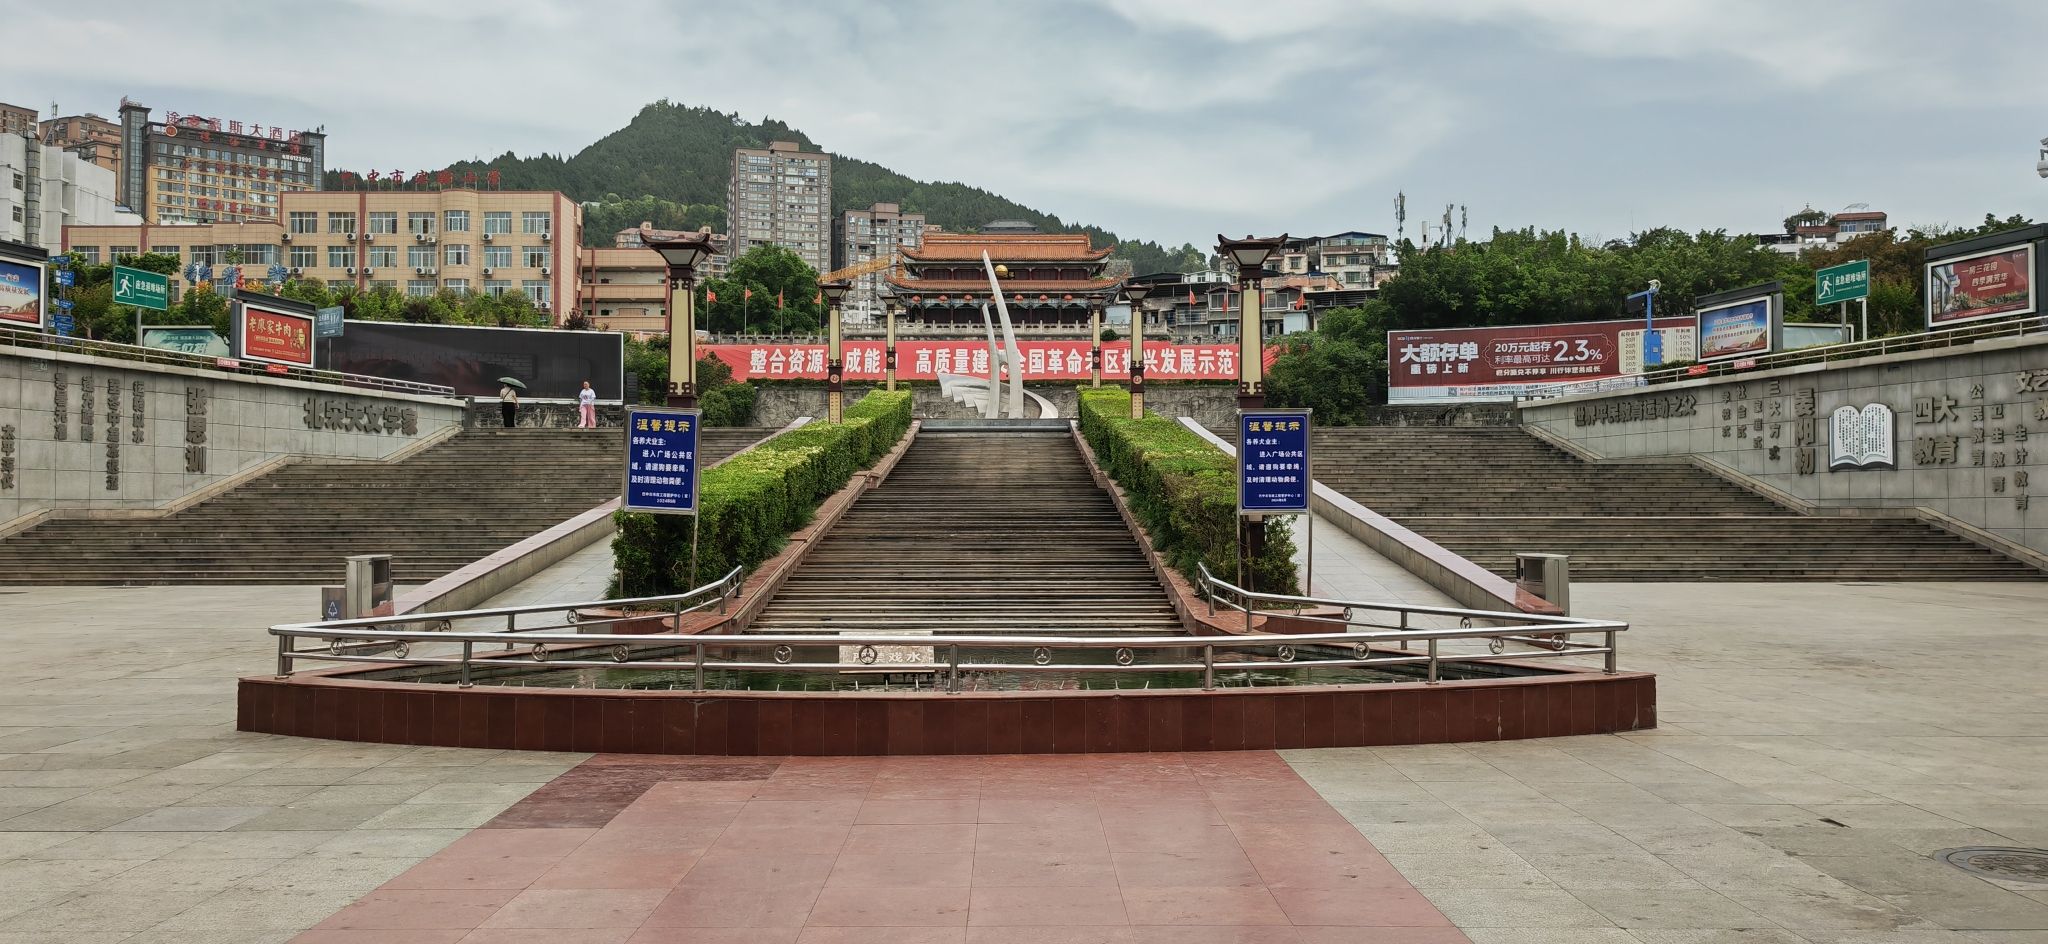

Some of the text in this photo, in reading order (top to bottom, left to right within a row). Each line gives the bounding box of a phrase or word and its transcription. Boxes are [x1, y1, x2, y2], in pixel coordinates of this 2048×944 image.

[249, 317, 292, 338] 老廖家牛肉
[750, 348, 1239, 375] 整合资源成能 高质量建国革命区兴发展示范
[1400, 342, 1479, 363] 大额存单
[1494, 341, 1552, 353] 20万元起存
[1494, 354, 1551, 364] 利率最高可达
[1553, 339, 1603, 362] 2.3%
[1410, 363, 1469, 375] 重磅上新
[303, 398, 418, 435] 北宋天文学家
[1573, 395, 1698, 427] 世界平民教育运动之父
[1736, 385, 1747, 438] 社会式
[1769, 380, 1781, 461] 三大方式
[1914, 395, 1959, 424] 四大
[185, 387, 208, 474] 张思训
[636, 418, 691, 432] 温馨提示
[1249, 421, 1300, 432] 温馨提示
[1794, 388, 1816, 476] 晏阳初
[1970, 384, 1985, 466] 公民教育
[642, 450, 693, 459] 进入广场公共区
[1914, 435, 1959, 465] 教育
[1991, 404, 2006, 493] 卫生教育
[2014, 424, 2029, 511] 生计教育
